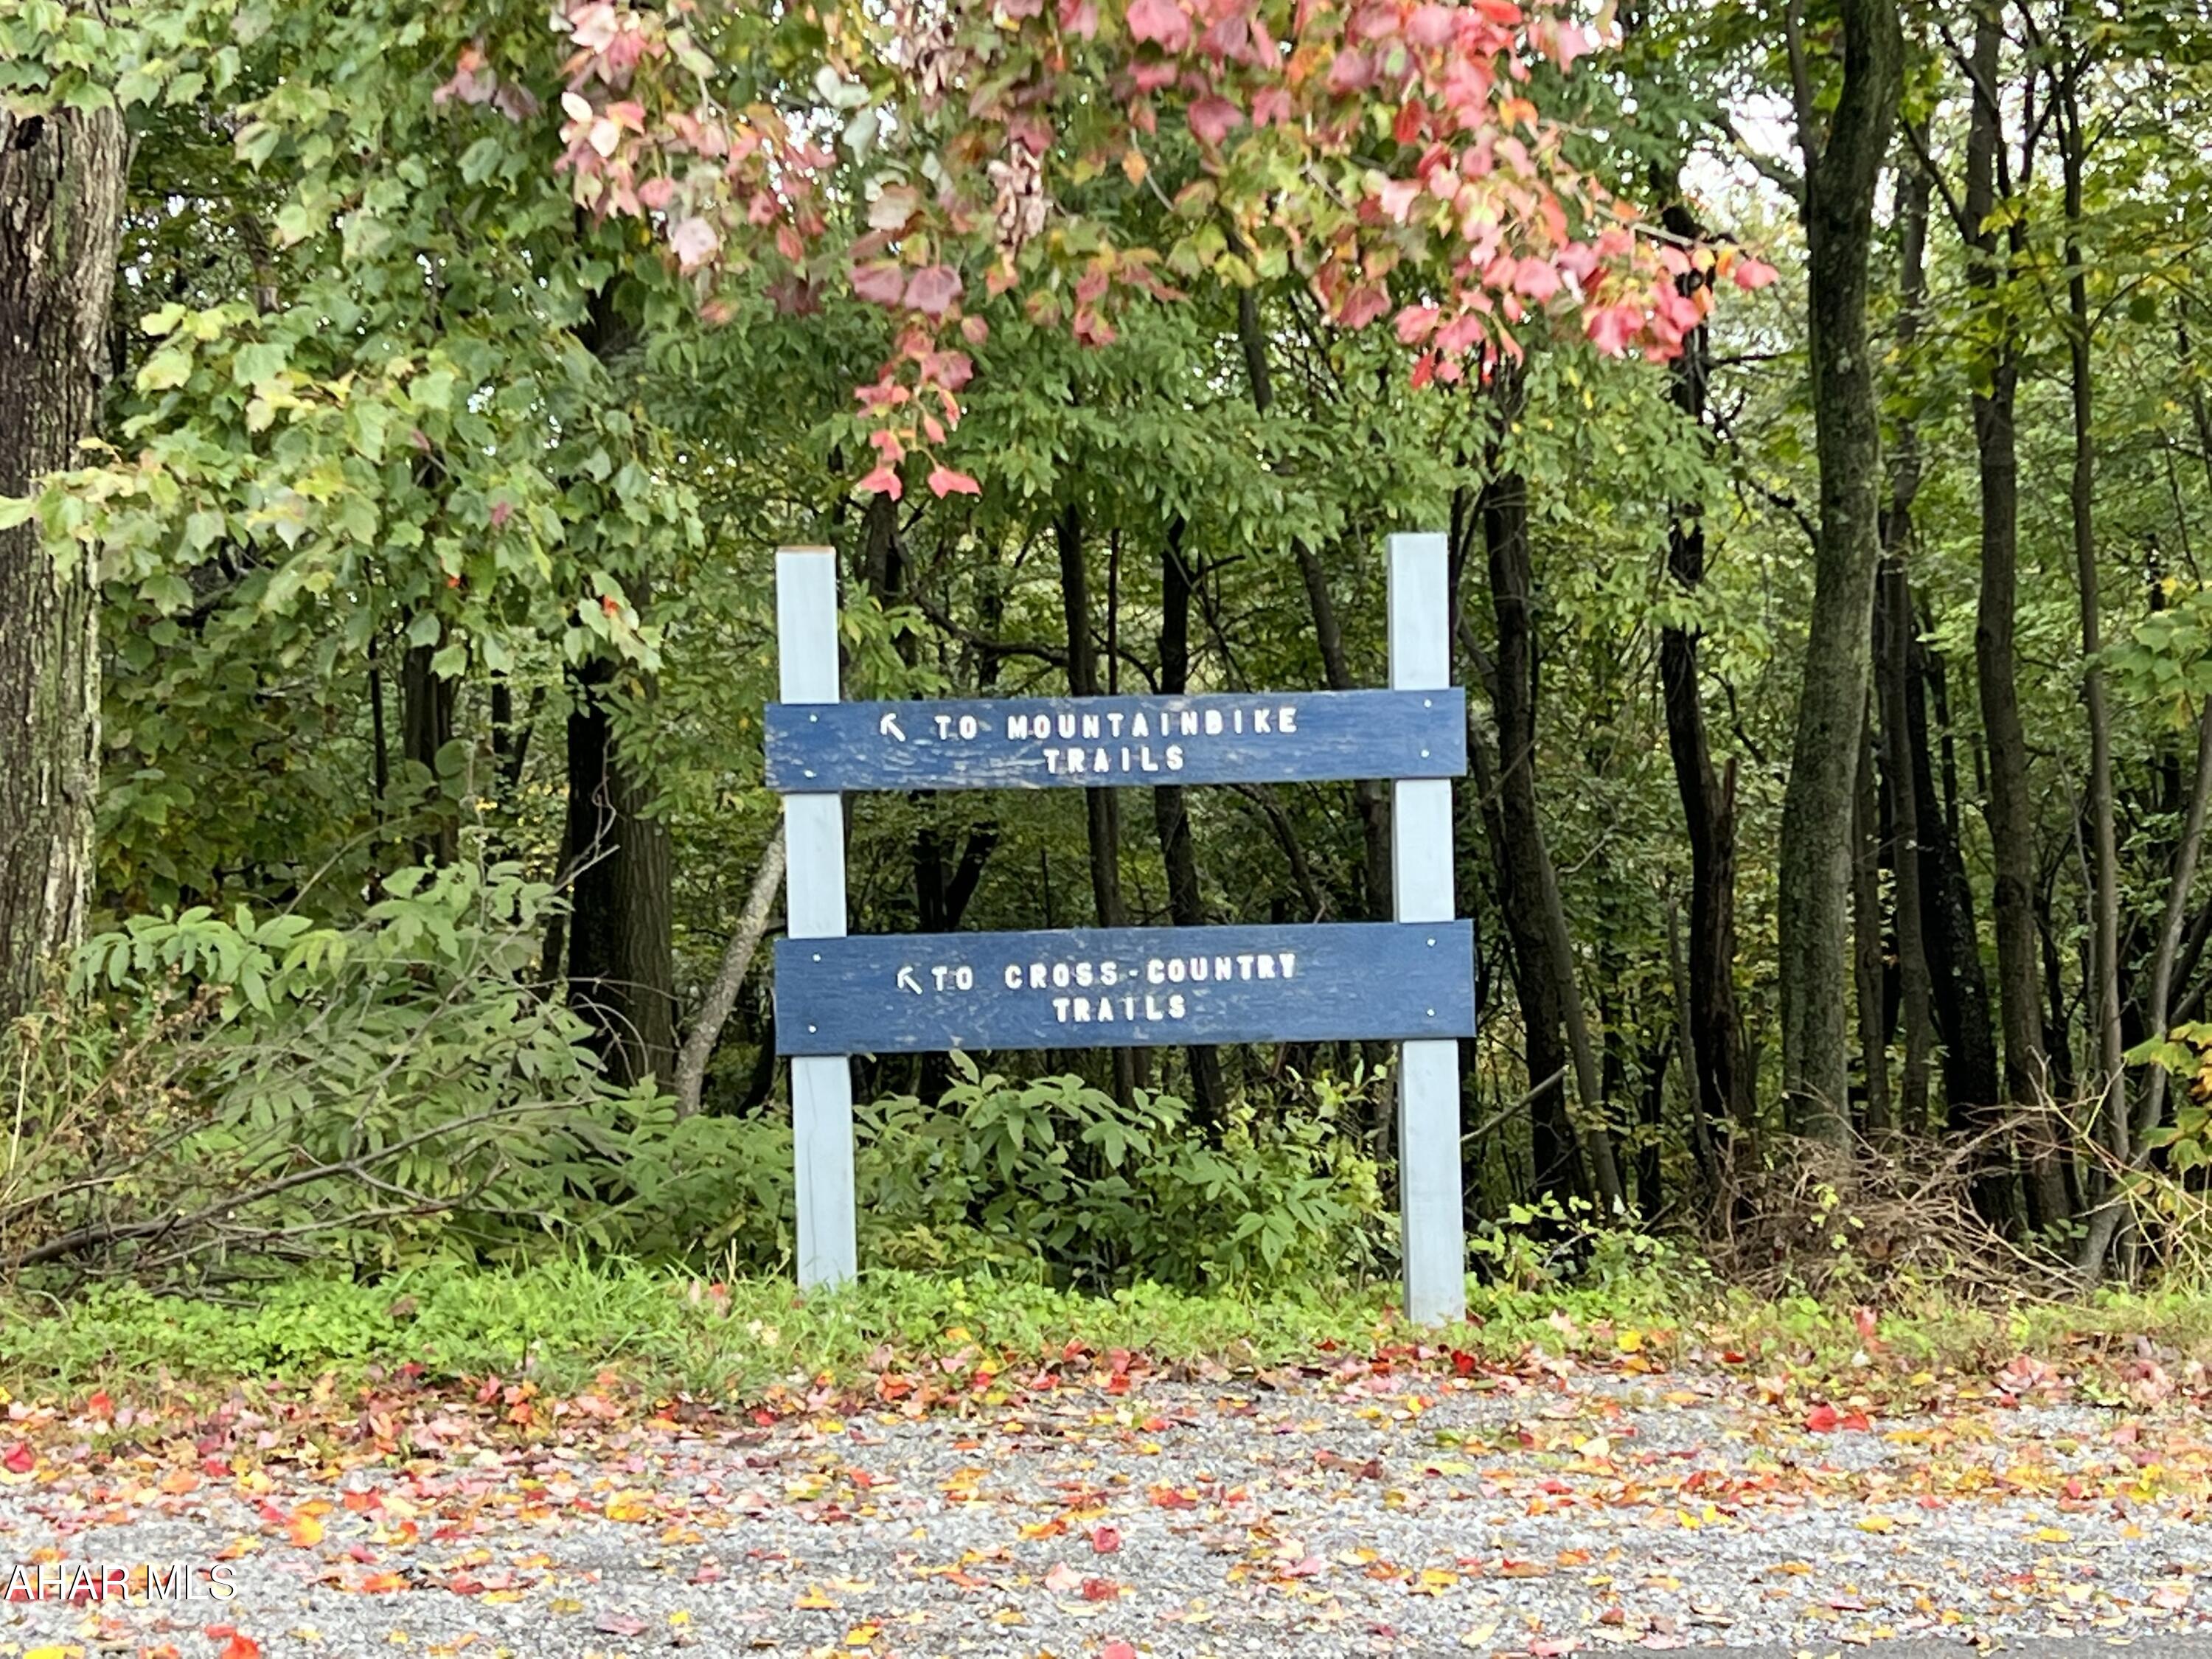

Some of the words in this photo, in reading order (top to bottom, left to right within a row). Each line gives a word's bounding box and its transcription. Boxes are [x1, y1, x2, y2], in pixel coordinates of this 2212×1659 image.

[934, 714, 978, 740] TO
[1007, 708, 1298, 740] MOUNTAINBIKE
[1043, 745, 1185, 774] TRAILS
[931, 966, 974, 992] TO
[1052, 995, 1186, 1023] TRAILS
